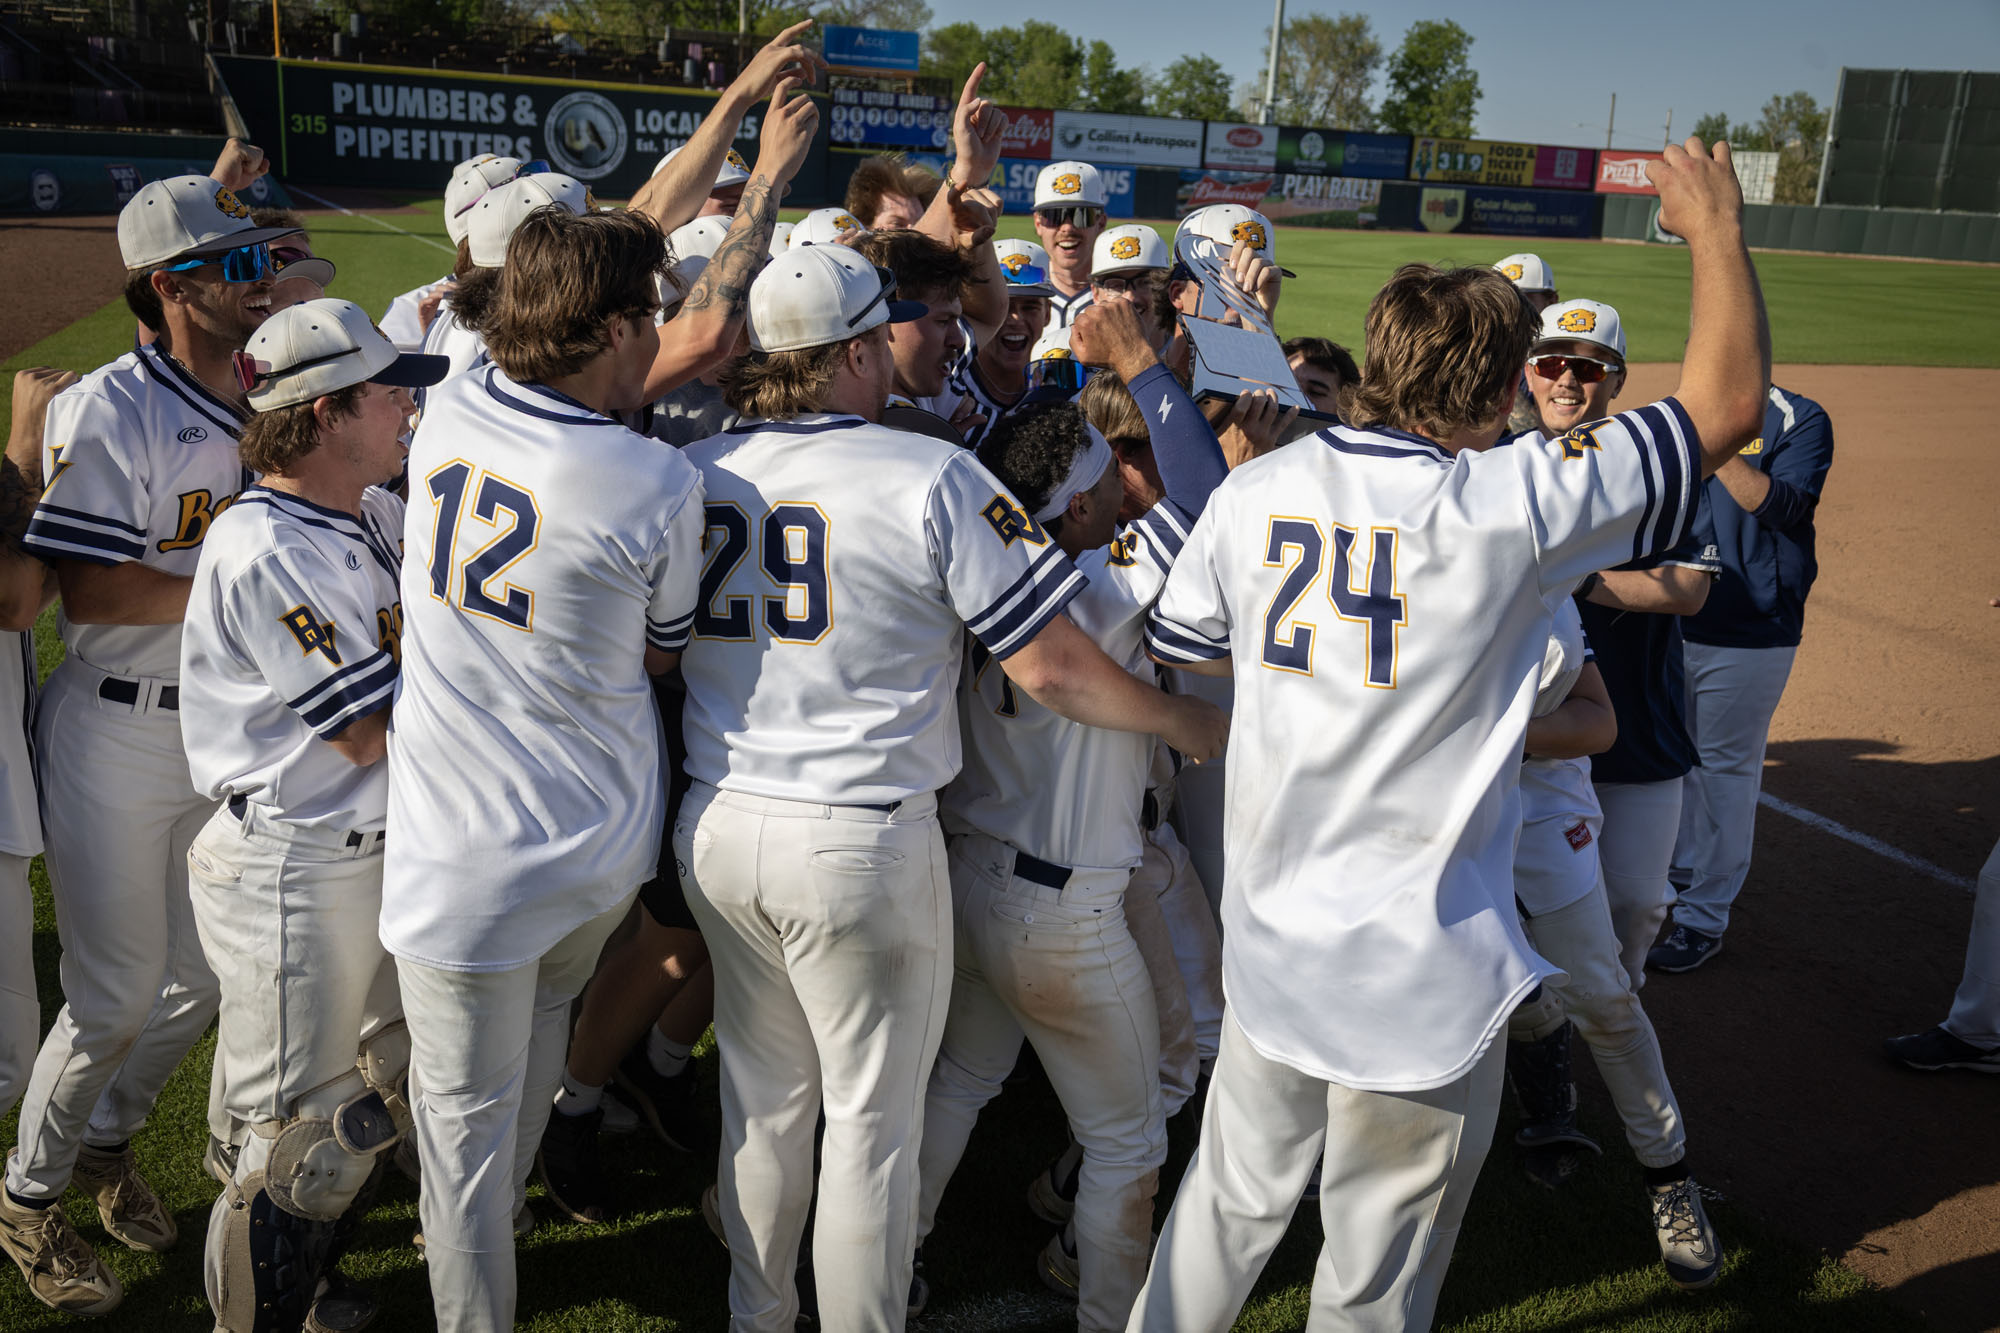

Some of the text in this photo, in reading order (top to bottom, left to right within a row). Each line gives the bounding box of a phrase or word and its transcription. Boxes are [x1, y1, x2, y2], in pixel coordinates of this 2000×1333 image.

[332, 82, 538, 127] PLUMBERS &
[290, 114, 327, 135] 315
[335, 125, 532, 164] PIPEFITTERS
[635, 138, 659, 154] Est.
[1088, 128, 1130, 143] Collins
[1133, 131, 1197, 151] Aerospace
[1488, 144, 1536, 159] FOOD &
[1487, 157, 1528, 171] TICKET
[1282, 173, 1377, 201] PLAY BALL!
[1486, 171, 1523, 185] DEALS
[1194, 181, 1265, 200] Budweiser
[1473, 198, 1501, 210] Cedar
[424, 457, 543, 633] 12
[691, 500, 834, 645] 29
[1260, 514, 1408, 690] 24
